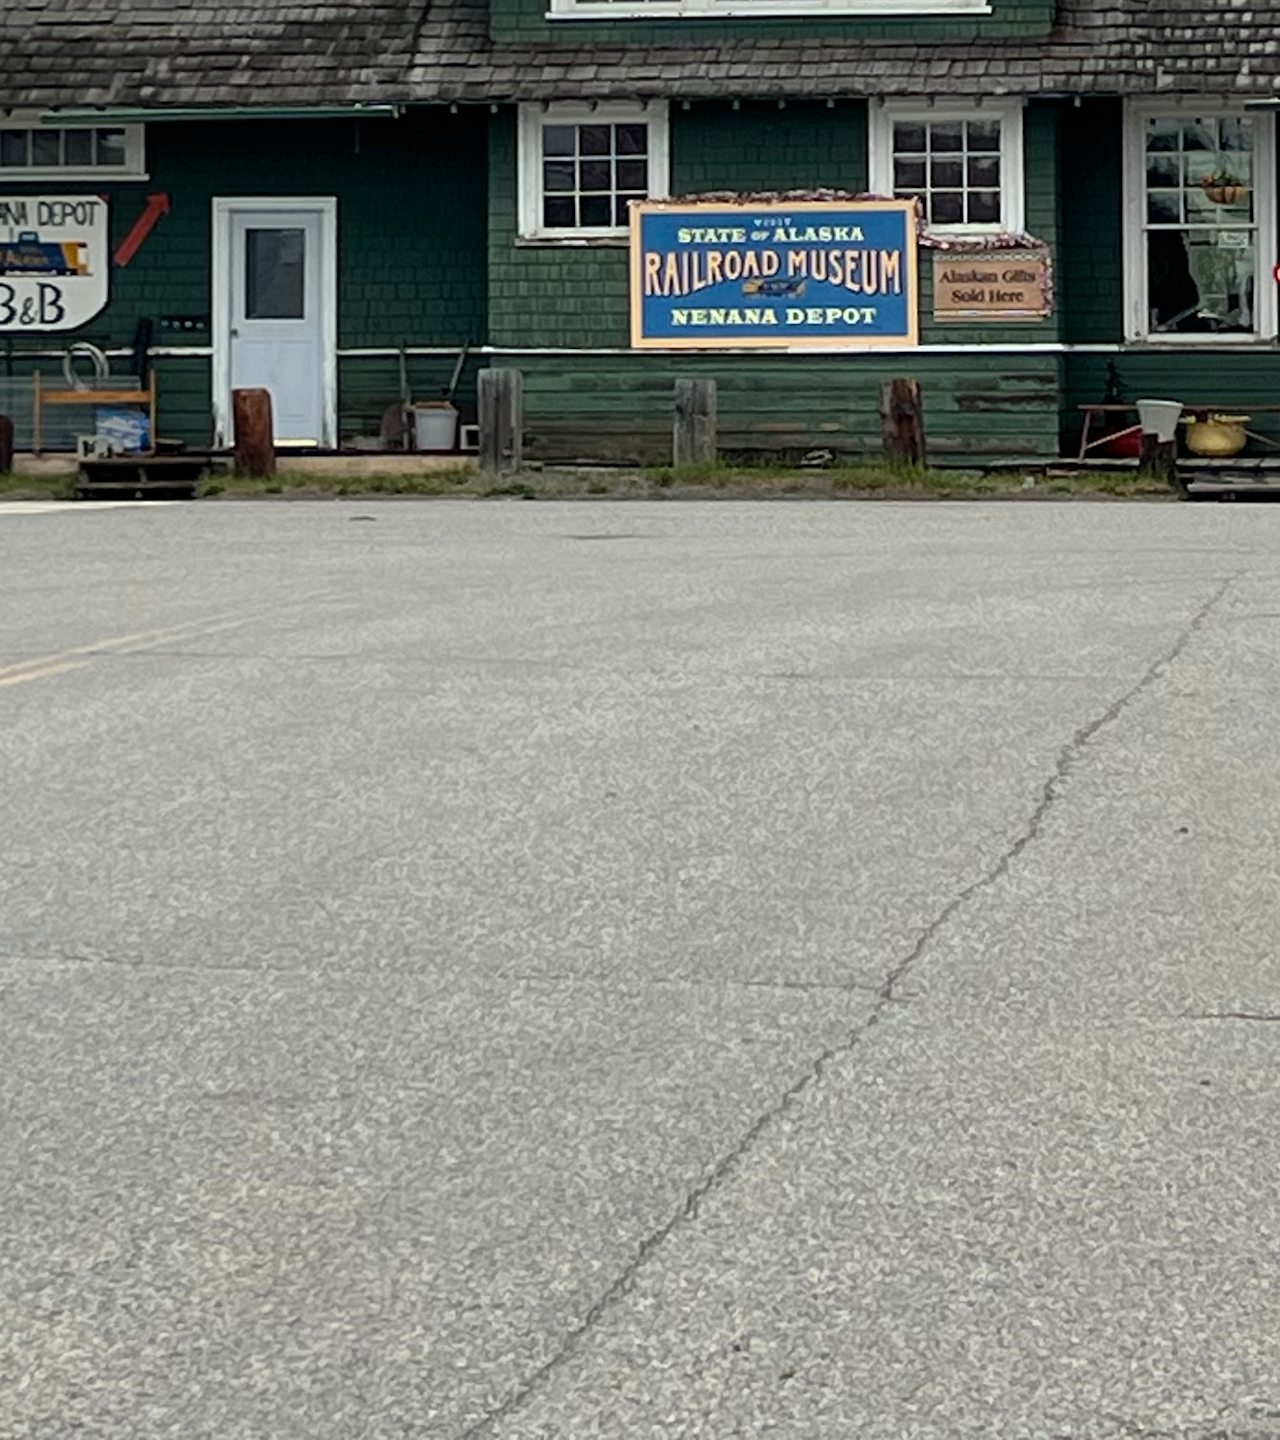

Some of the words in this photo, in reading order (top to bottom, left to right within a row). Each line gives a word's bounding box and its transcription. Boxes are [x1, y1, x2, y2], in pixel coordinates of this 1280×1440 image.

[37, 201, 101, 226] DEPOT
[678, 228, 746, 243] STATE
[772, 226, 865, 242] ALASKA
[644, 249, 780, 296] RAILROAD
[787, 249, 902, 295] MUSEUM
[939, 269, 998, 283] Alaskan
[951, 288, 985, 303] Sold
[989, 289, 1024, 303] Here
[671, 308, 779, 326] NENANA
[785, 307, 877, 325] DEPOT
